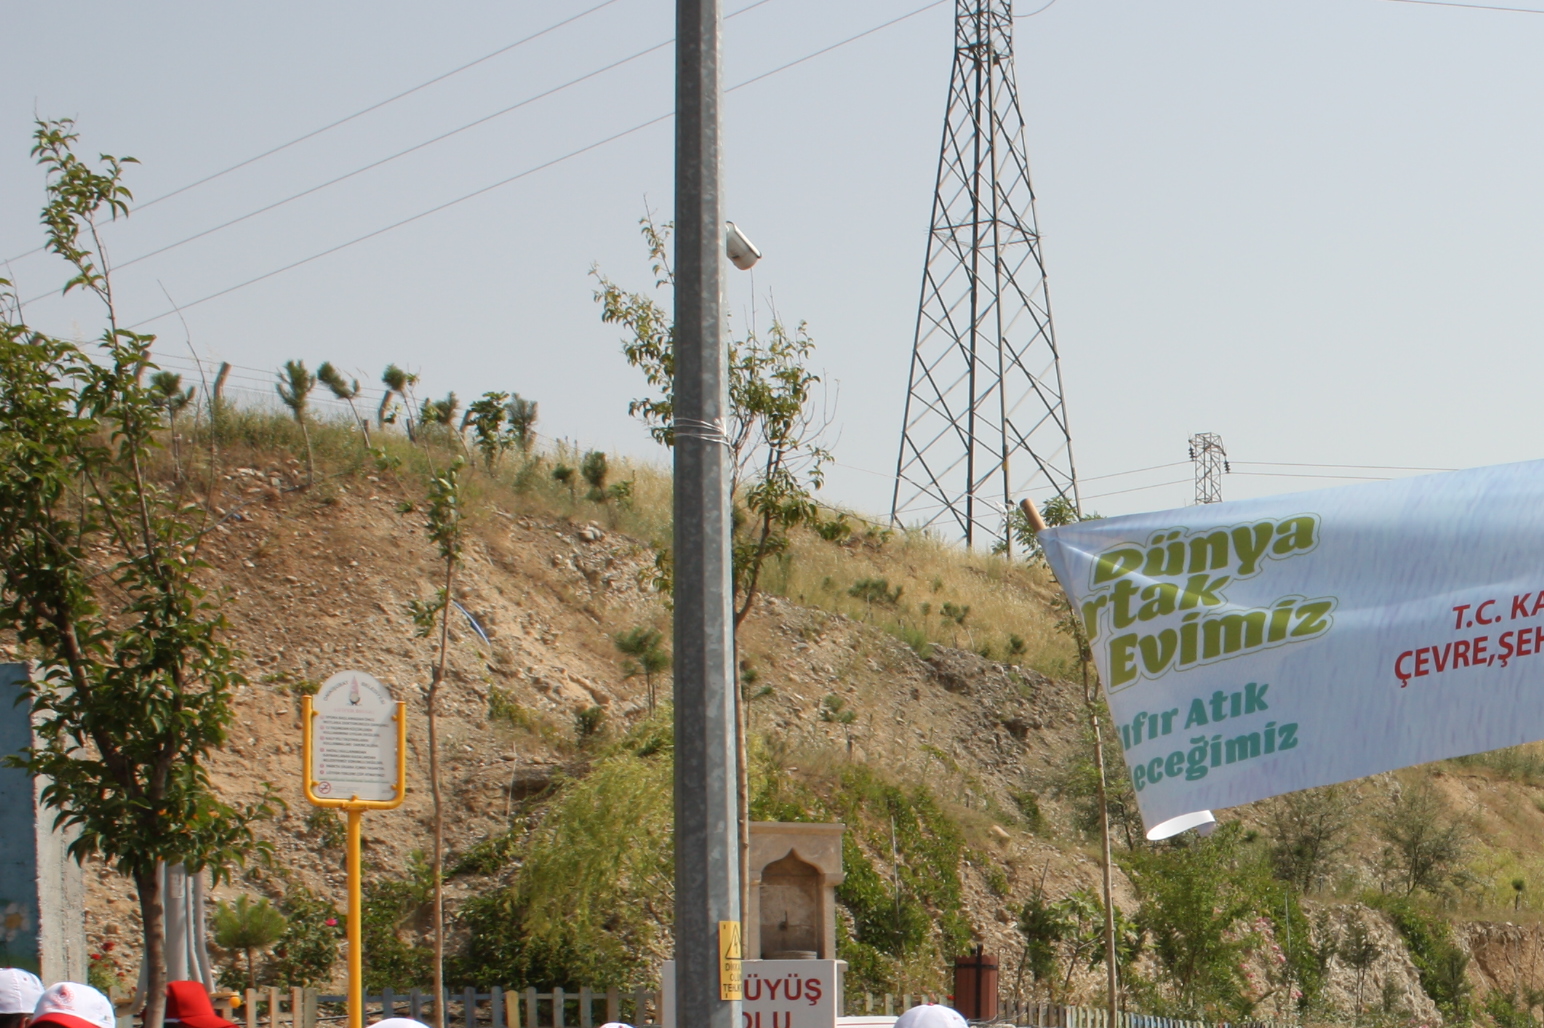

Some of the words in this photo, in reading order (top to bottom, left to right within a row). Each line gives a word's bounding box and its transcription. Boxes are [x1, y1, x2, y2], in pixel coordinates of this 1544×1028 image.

[1093, 516, 1315, 585] Dünya
[1081, 573, 1232, 641] rtak
[1453, 599, 1502, 630] T.C.
[1109, 600, 1333, 688] Evimiz
[1117, 707, 1179, 751] ıfır
[1184, 682, 1269, 730] Atık
[1129, 721, 1299, 793] eceğimiz
[744, 973, 822, 1006] ÜYÜŞ
